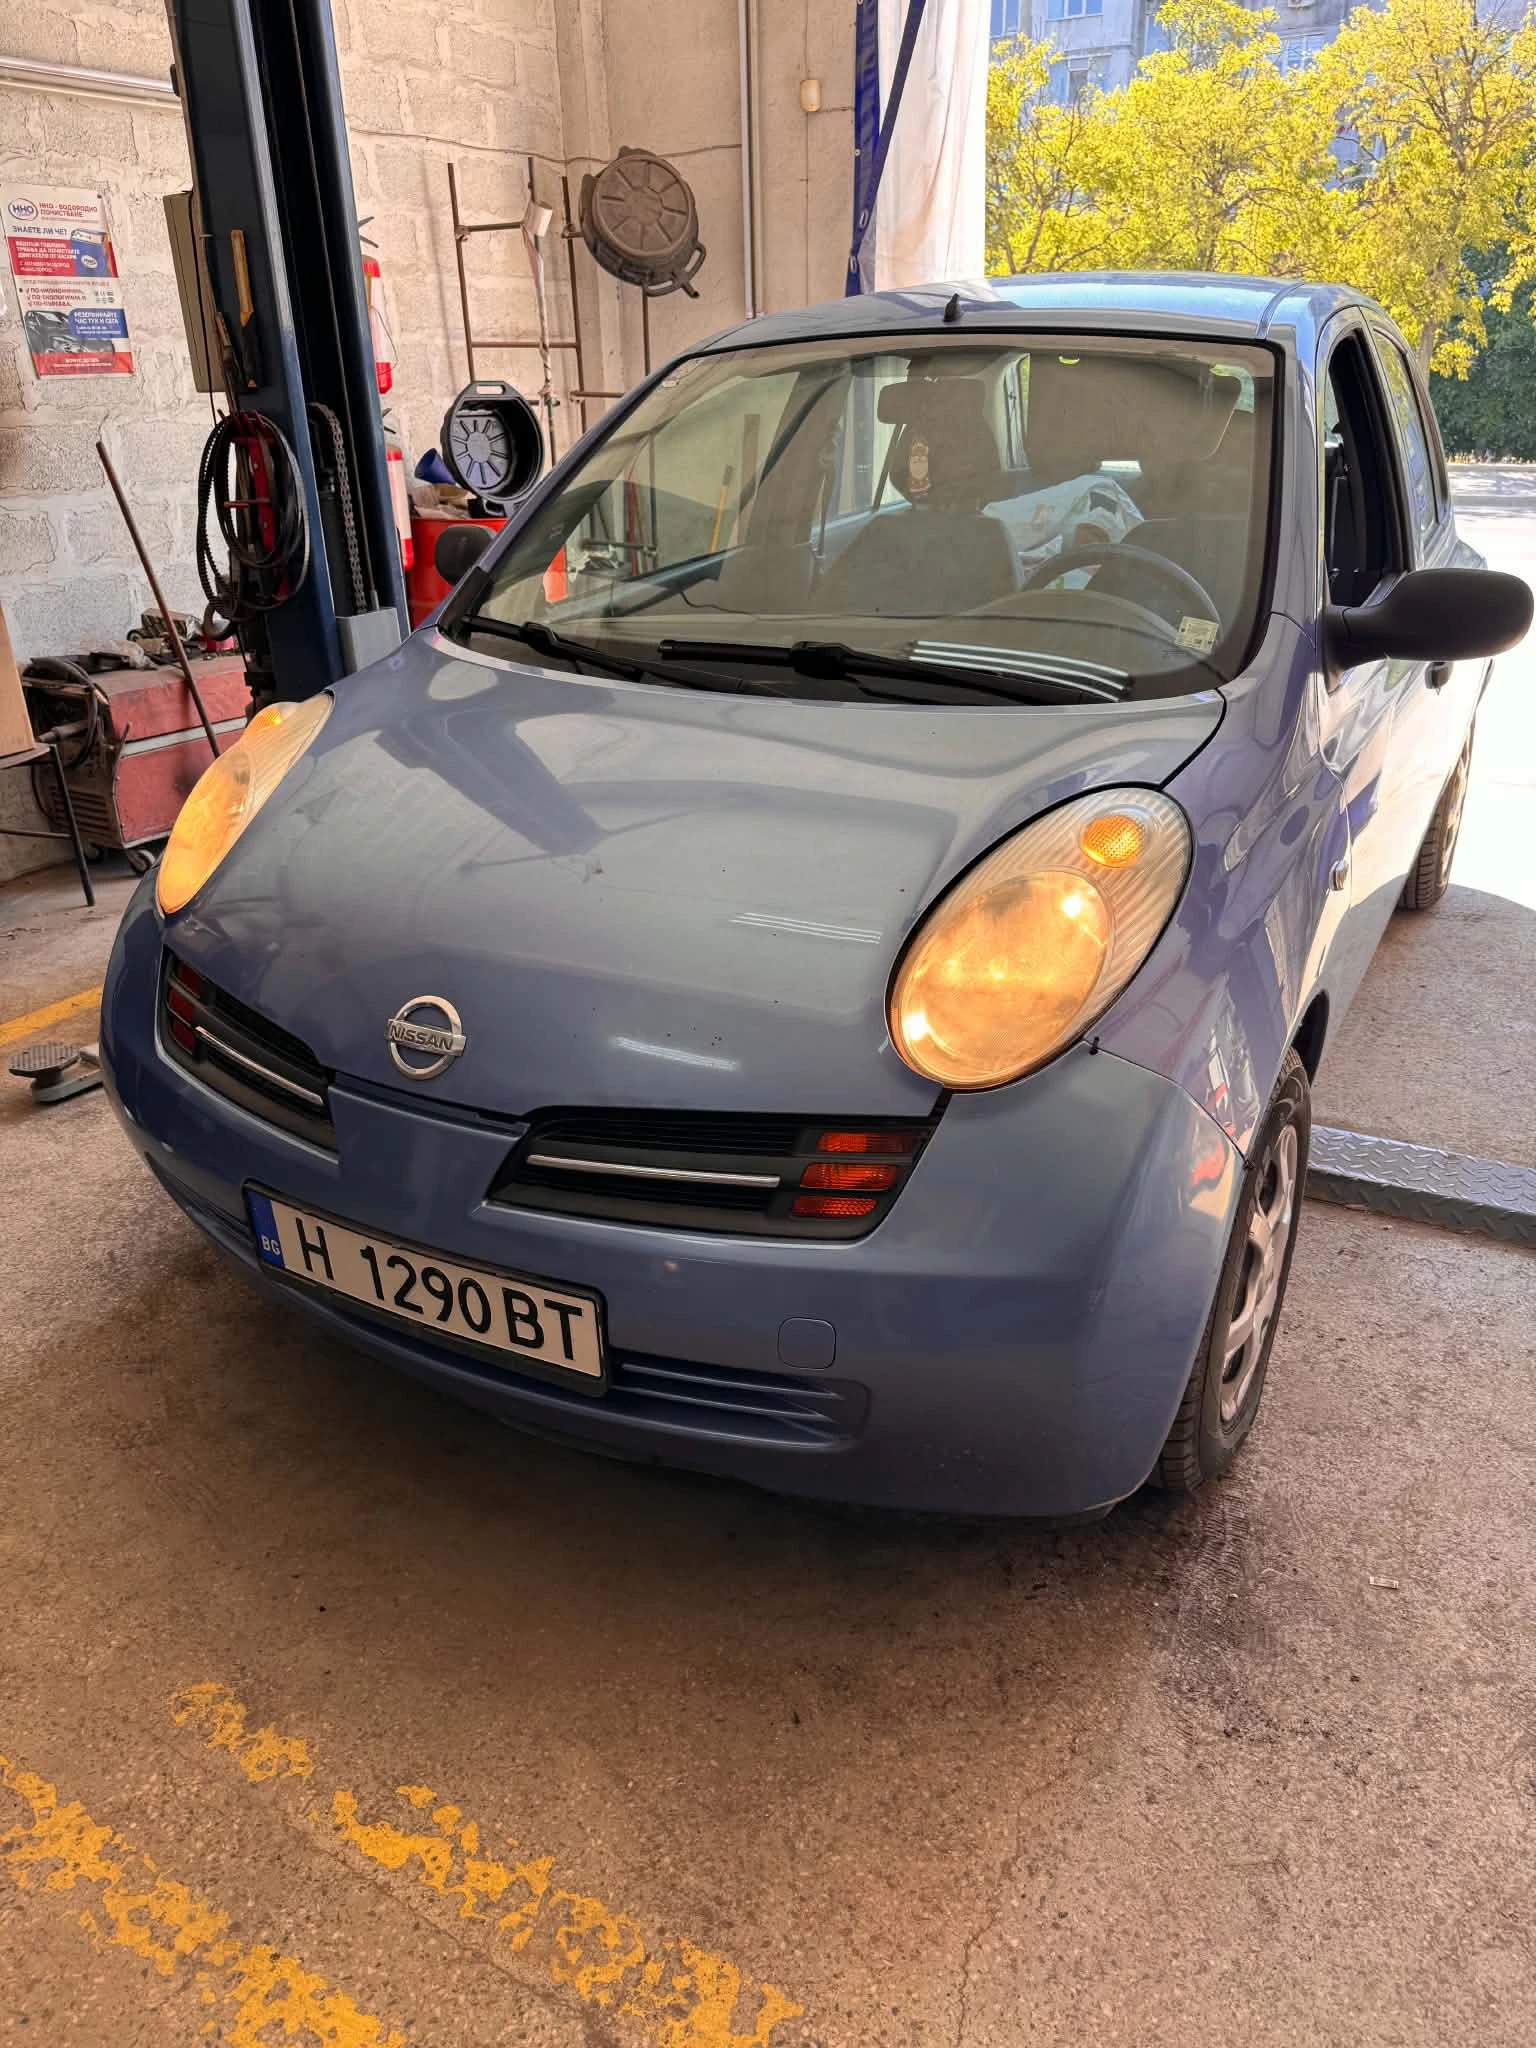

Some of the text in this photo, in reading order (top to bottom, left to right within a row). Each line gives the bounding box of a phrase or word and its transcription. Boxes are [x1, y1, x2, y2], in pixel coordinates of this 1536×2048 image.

[40, 209, 83, 218] ПОЧИСТВАНЕ
[59, 203, 98, 213] ВОДОРОДНО
[13, 225, 41, 234] ЗНАЕТЕ
[43, 227, 54, 235] ЛИ
[390, 1025, 454, 1050] NISSAN
[262, 1235, 280, 1256] BG
[295, 1217, 583, 1360] H 1290 BT
